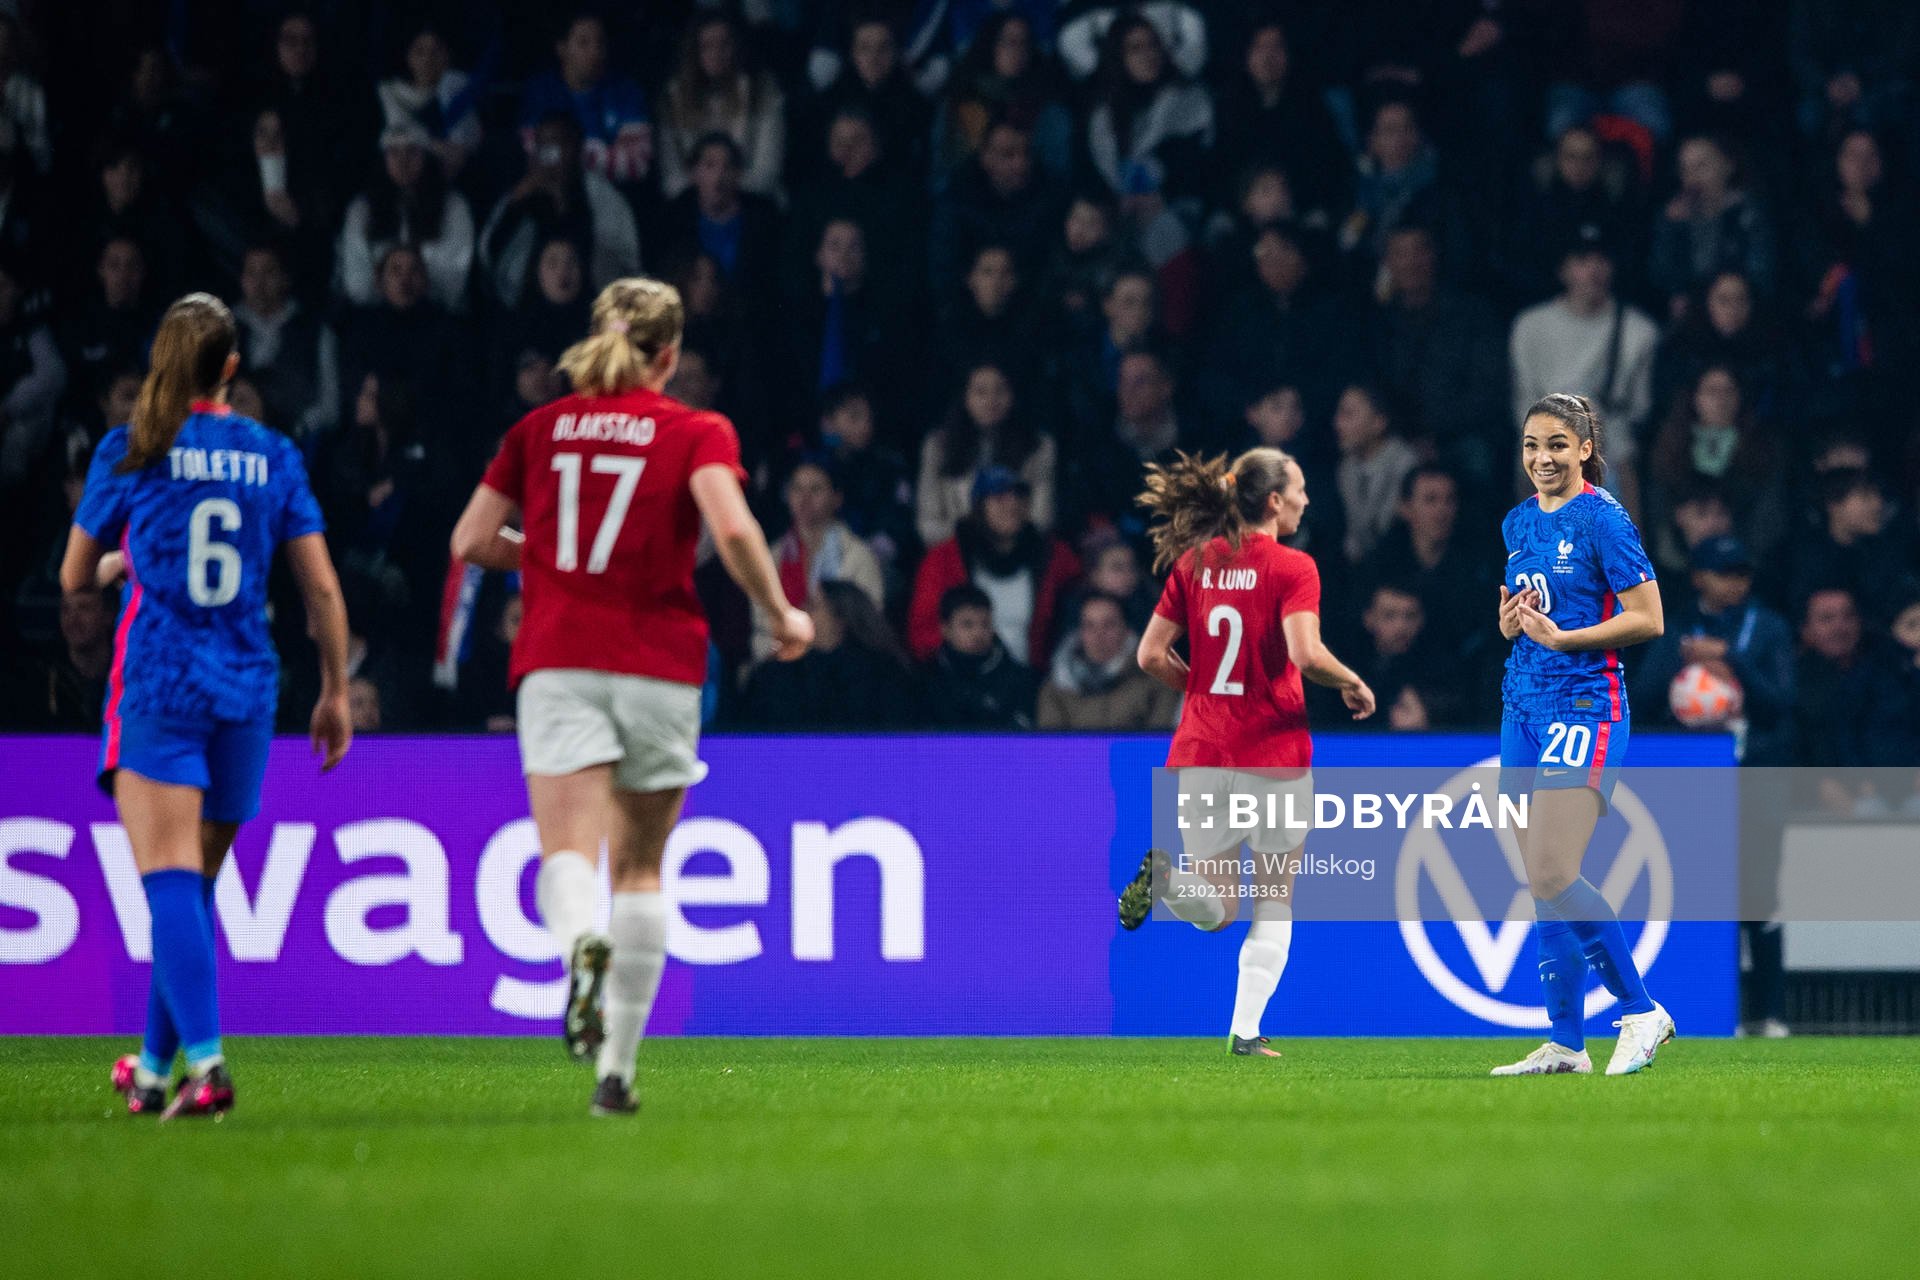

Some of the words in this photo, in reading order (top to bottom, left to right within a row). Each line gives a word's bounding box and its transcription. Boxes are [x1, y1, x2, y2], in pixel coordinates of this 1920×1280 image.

[552, 412, 657, 446] BLAKSTAD
[169, 447, 268, 487] TOLETTI
[550, 452, 646, 574] 17
[187, 497, 242, 608] 6
[1202, 567, 1214, 590] B.
[1218, 568, 1257, 590] LUND
[1208, 604, 1244, 695] 2
[1541, 721, 1591, 767] 20
